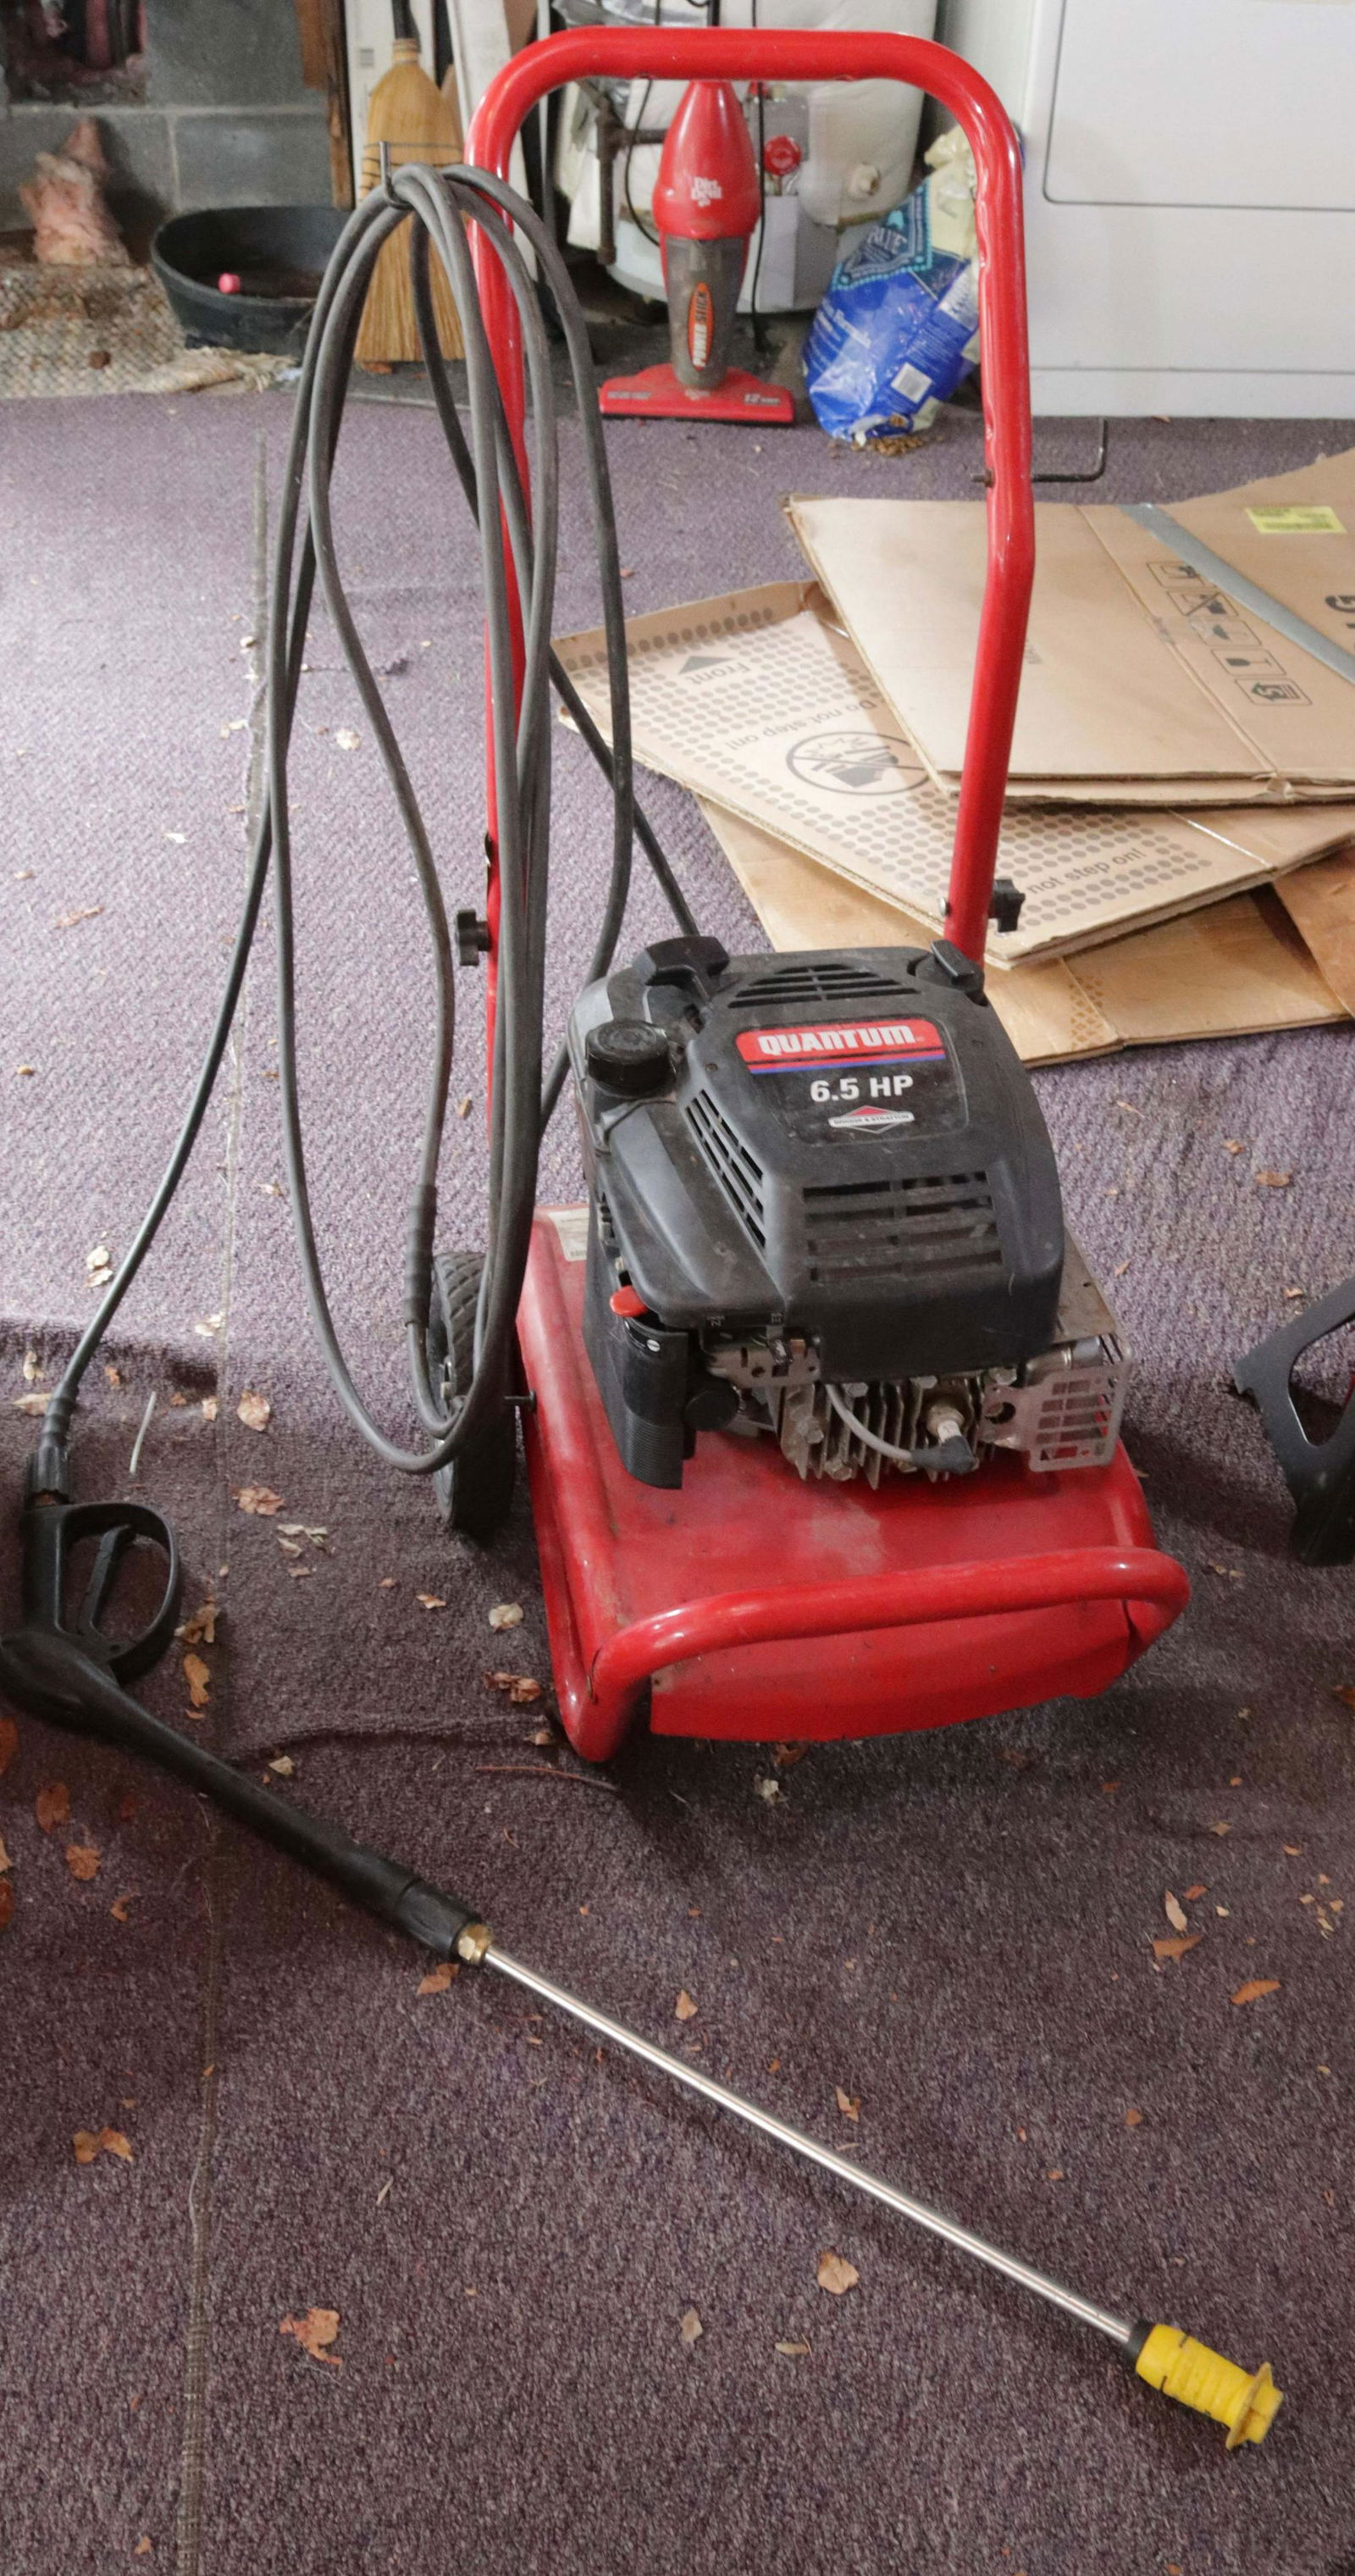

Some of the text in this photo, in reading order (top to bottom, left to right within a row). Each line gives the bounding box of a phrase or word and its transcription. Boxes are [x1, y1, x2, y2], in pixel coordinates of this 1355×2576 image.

[687, 662, 751, 684] Front
[814, 708, 843, 724] not
[847, 700, 877, 712] Do
[764, 721, 808, 736] step
[1026, 848, 1147, 895] not step on!
[758, 1026, 915, 1055] QUANTUM
[810, 1075, 914, 1102] 6.5 HP
